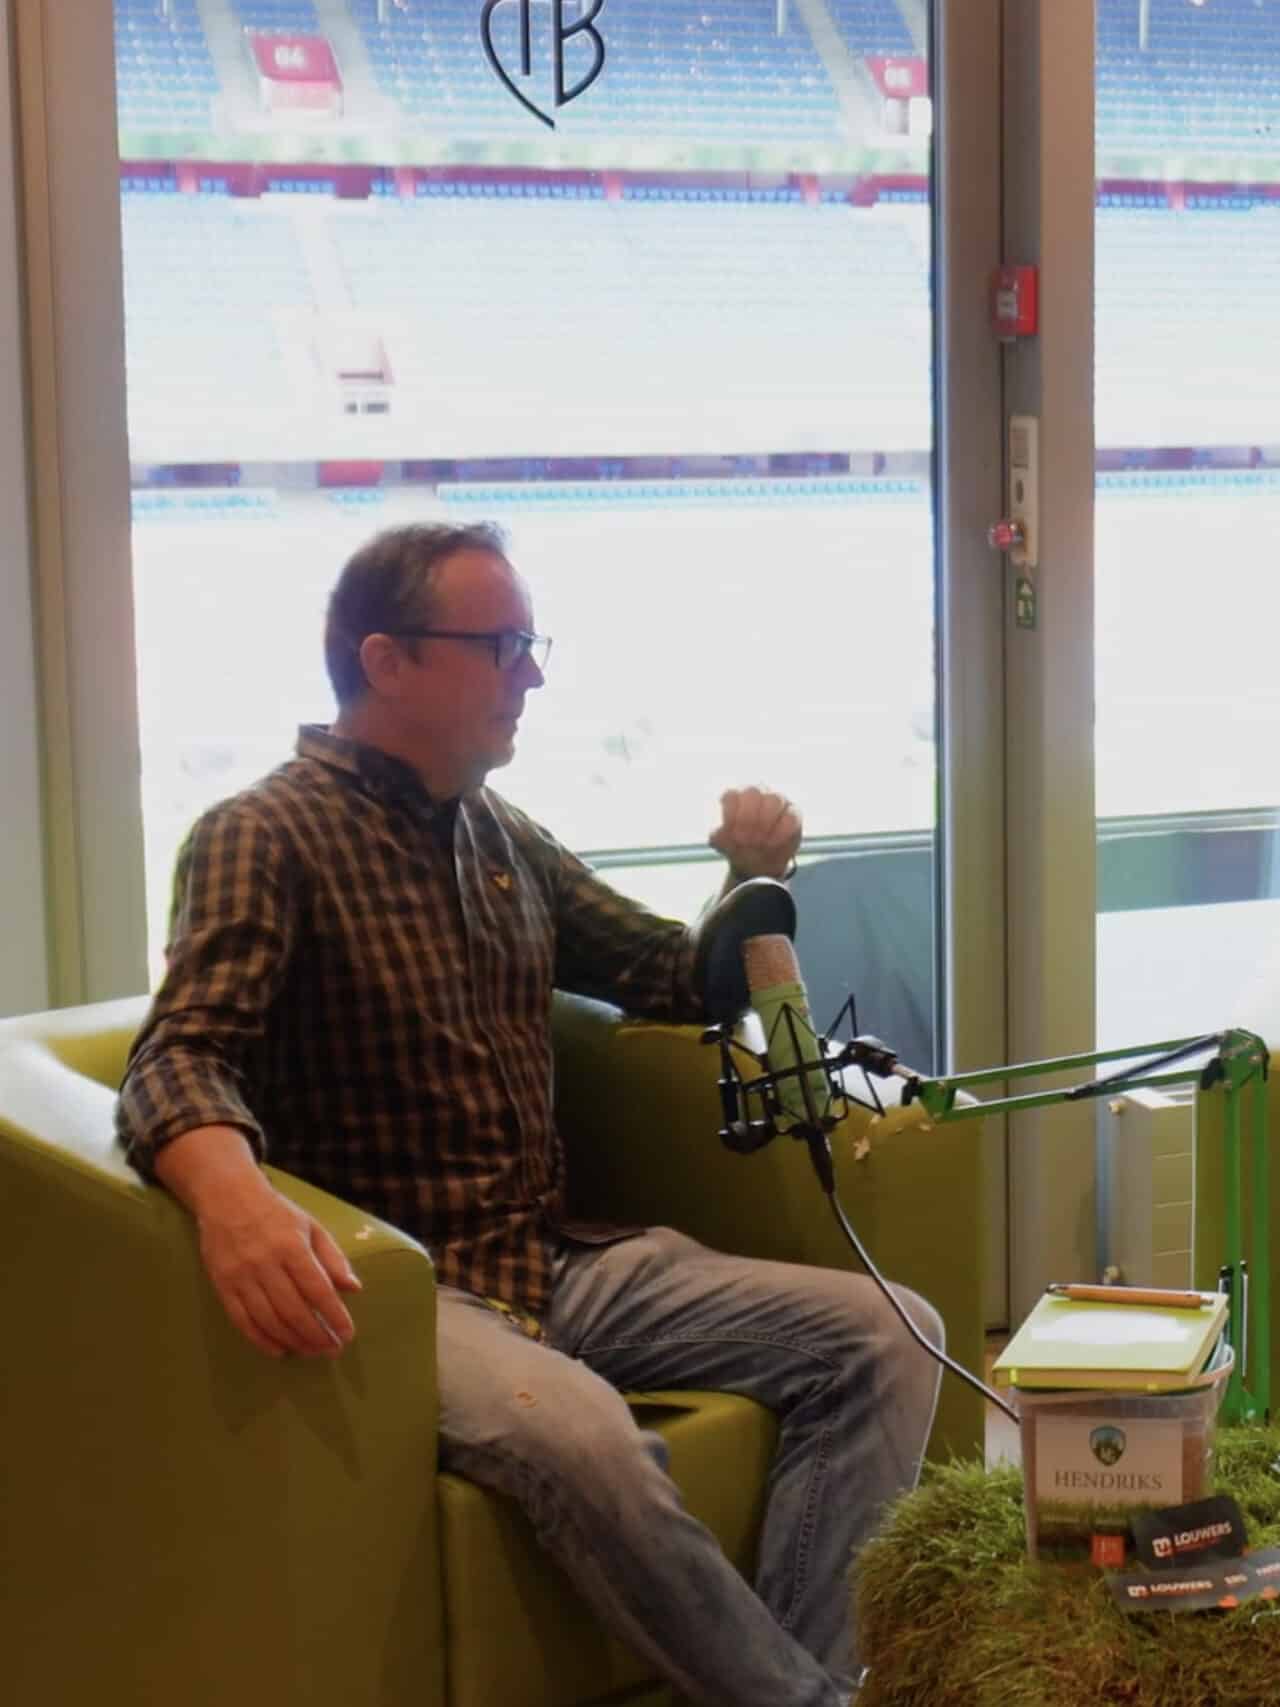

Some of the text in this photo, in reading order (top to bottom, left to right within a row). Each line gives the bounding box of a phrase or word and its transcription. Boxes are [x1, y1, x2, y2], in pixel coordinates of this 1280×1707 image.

[1055, 1471, 1163, 1489] HENDRIKS
[1173, 1521, 1233, 1548] LOUWERS
[1150, 1579, 1214, 1594] LOUWERS
